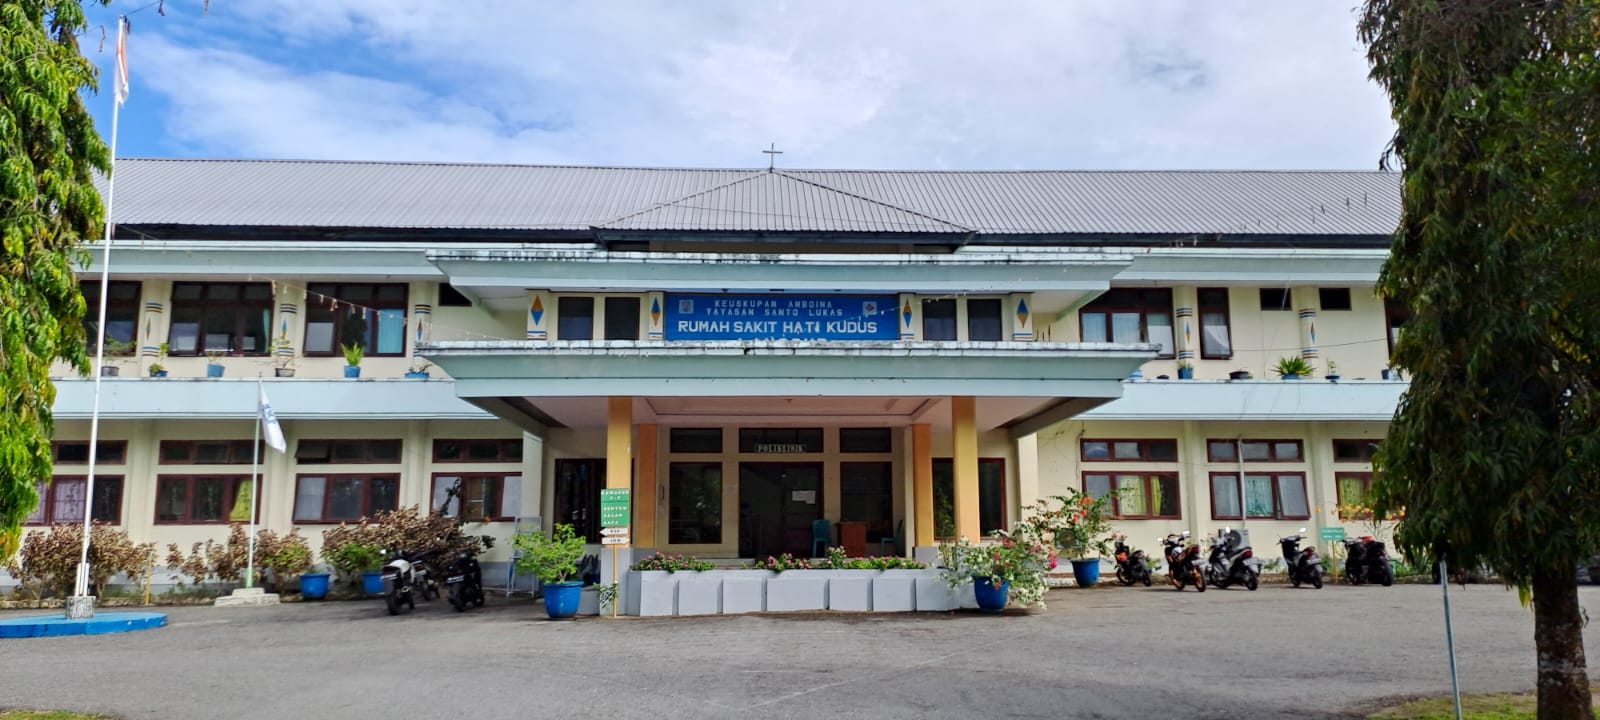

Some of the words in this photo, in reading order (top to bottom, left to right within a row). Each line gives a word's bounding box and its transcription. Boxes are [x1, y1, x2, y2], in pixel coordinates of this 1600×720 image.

[714, 300, 777, 308] KEUSKUPAN
[787, 300, 833, 308] AMBOINA
[706, 308, 755, 316] YAYASAN
[764, 308, 799, 316] SANTO
[808, 308, 844, 316] LUKAS
[678, 321, 730, 333] RUMAH
[733, 321, 778, 333] SAKIT
[783, 321, 821, 333] HATI
[826, 321, 878, 333] KUDUS
